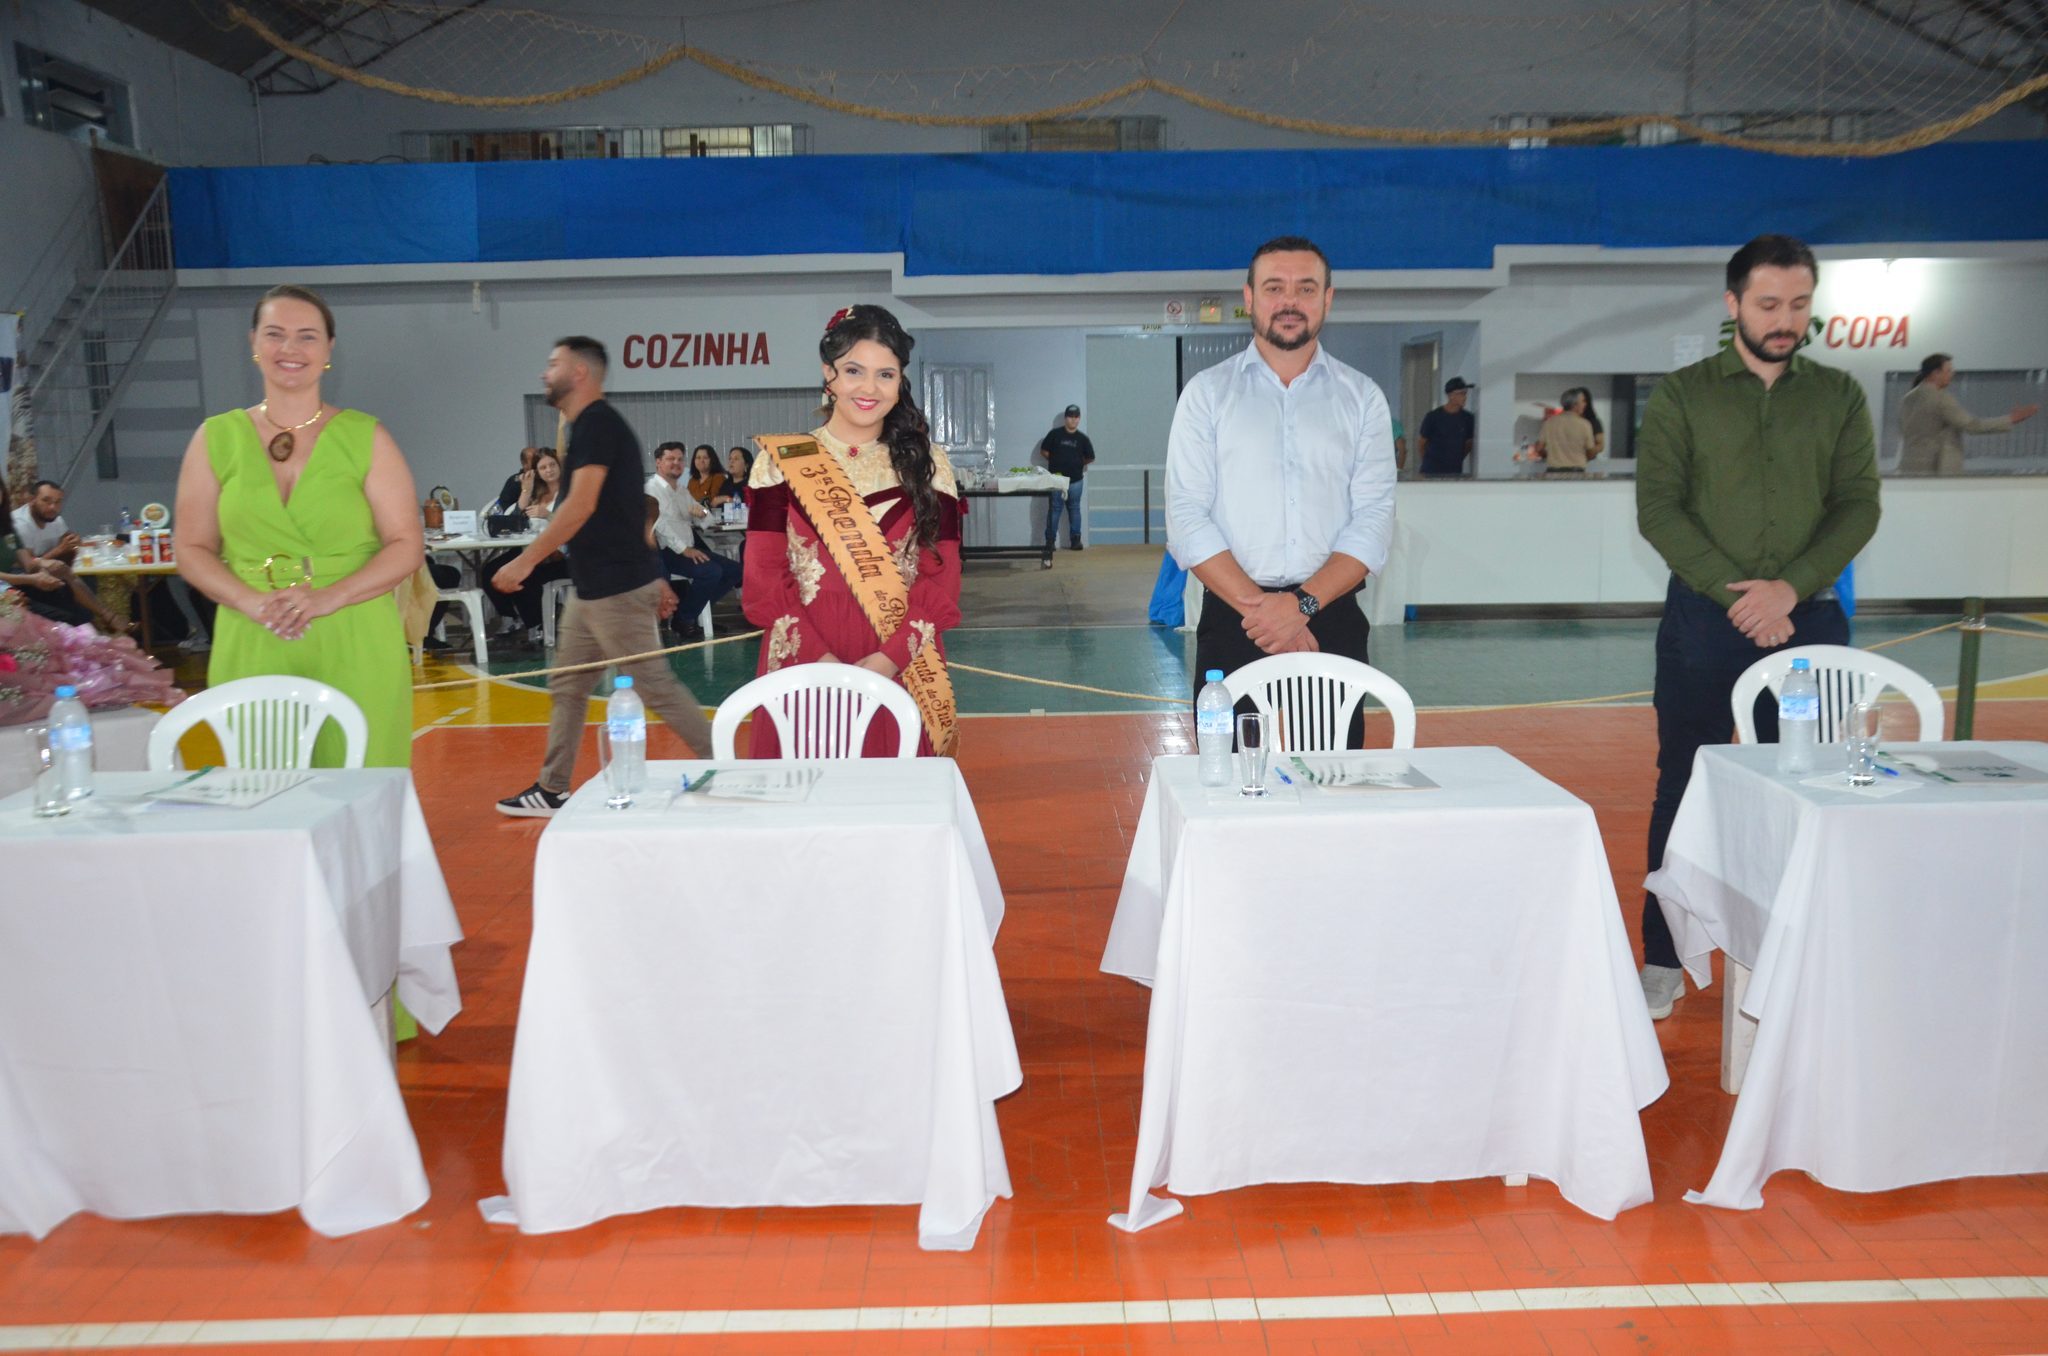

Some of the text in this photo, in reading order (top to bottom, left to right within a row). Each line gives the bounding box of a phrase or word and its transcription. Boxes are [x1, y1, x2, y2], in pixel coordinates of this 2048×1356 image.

[623, 332, 770, 369] COZINHA
[1825, 315, 1910, 349] COPA
[815, 486, 884, 582] Prenda
